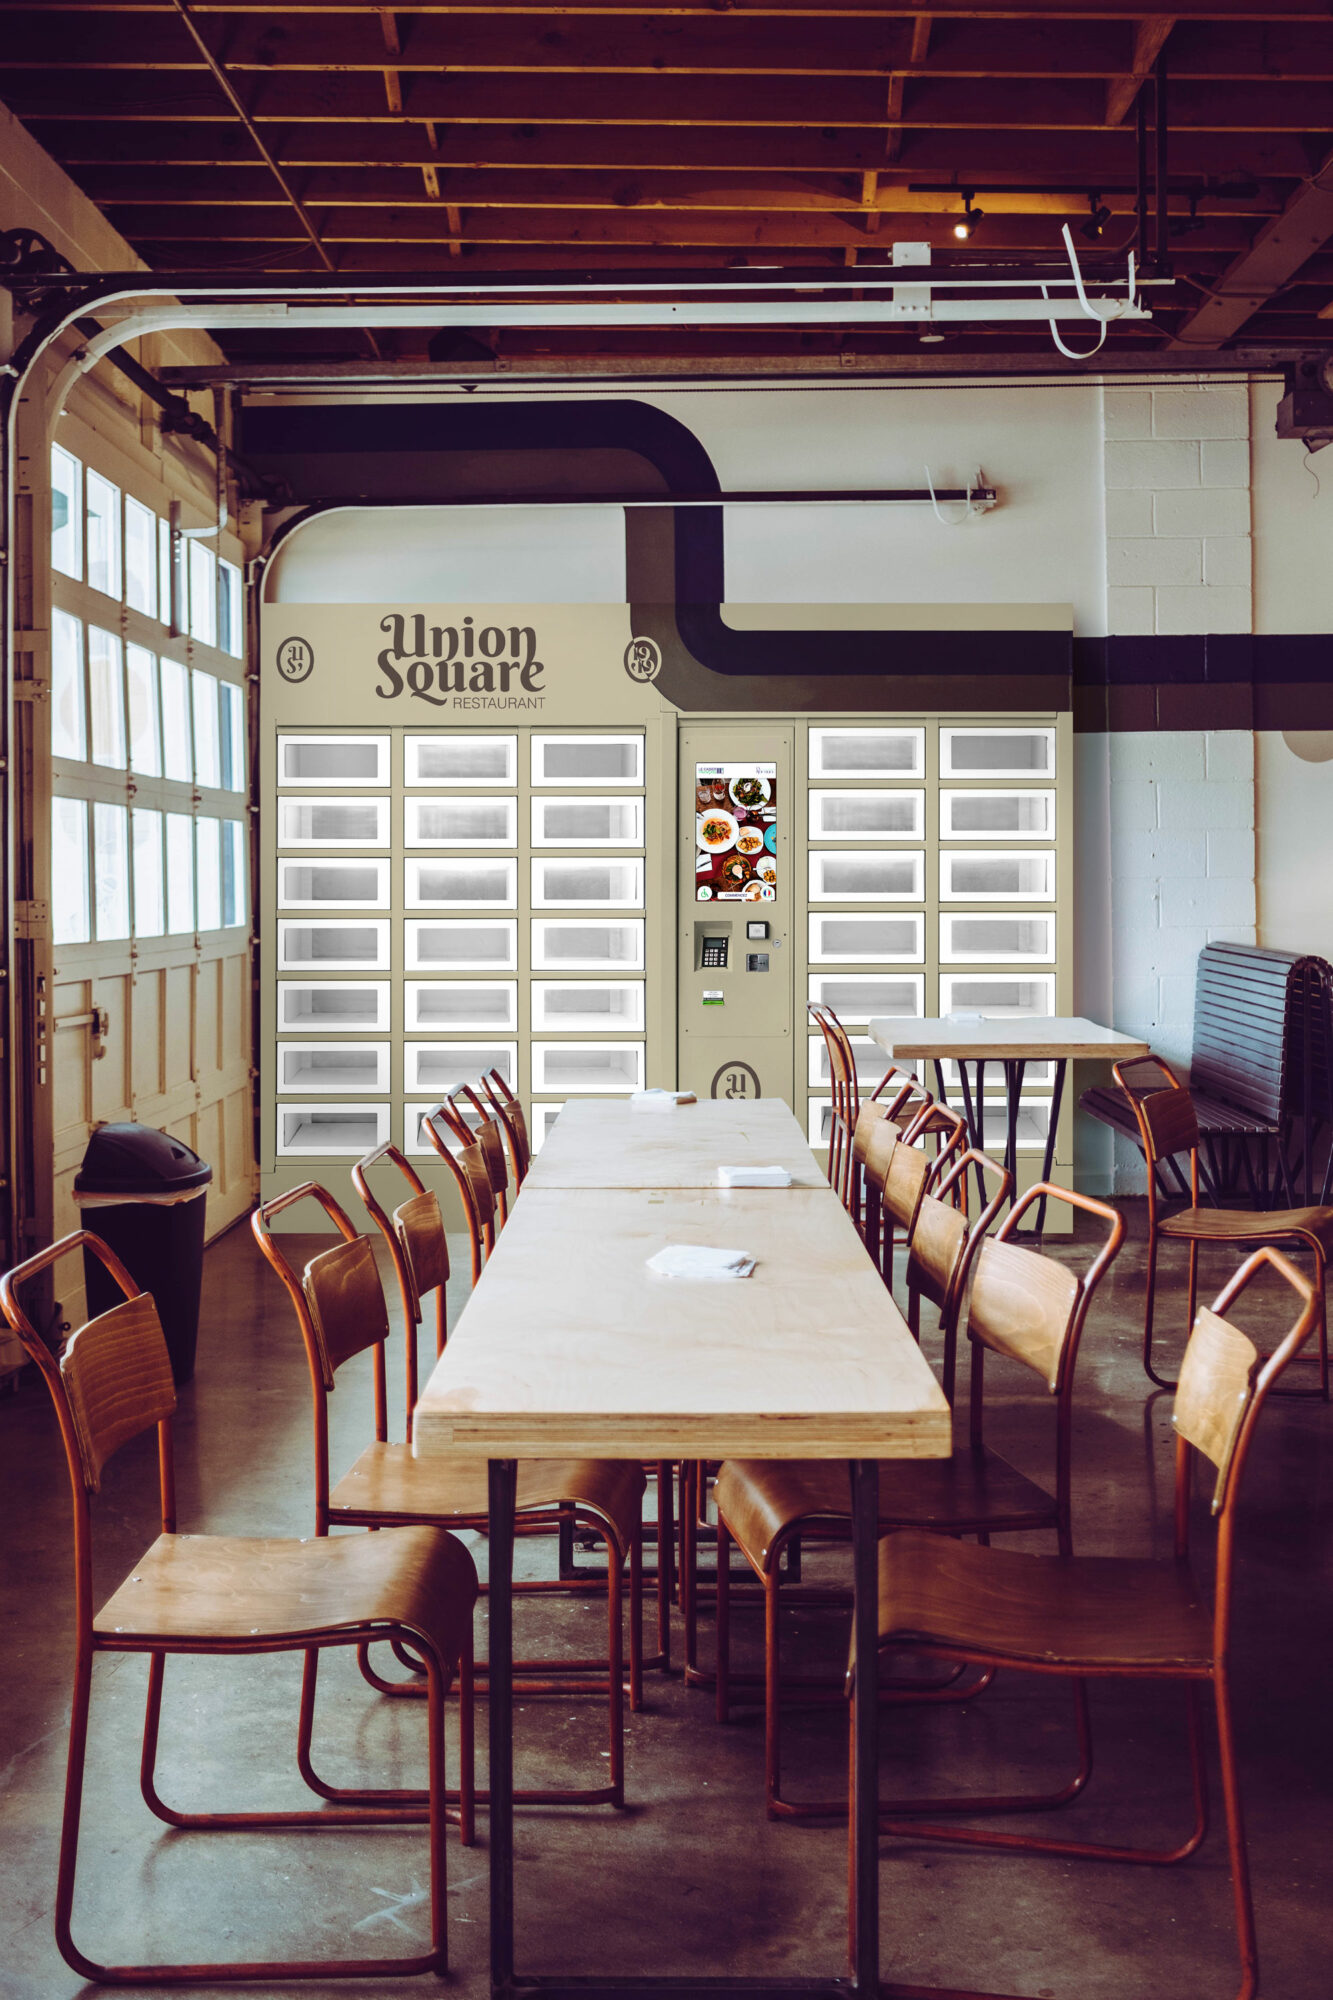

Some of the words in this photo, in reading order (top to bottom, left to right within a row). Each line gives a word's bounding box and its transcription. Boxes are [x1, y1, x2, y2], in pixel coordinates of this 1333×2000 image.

[380, 613, 537, 663] Union
[375, 648, 546, 706] Square
[453, 697, 546, 709] RESTAURANT
